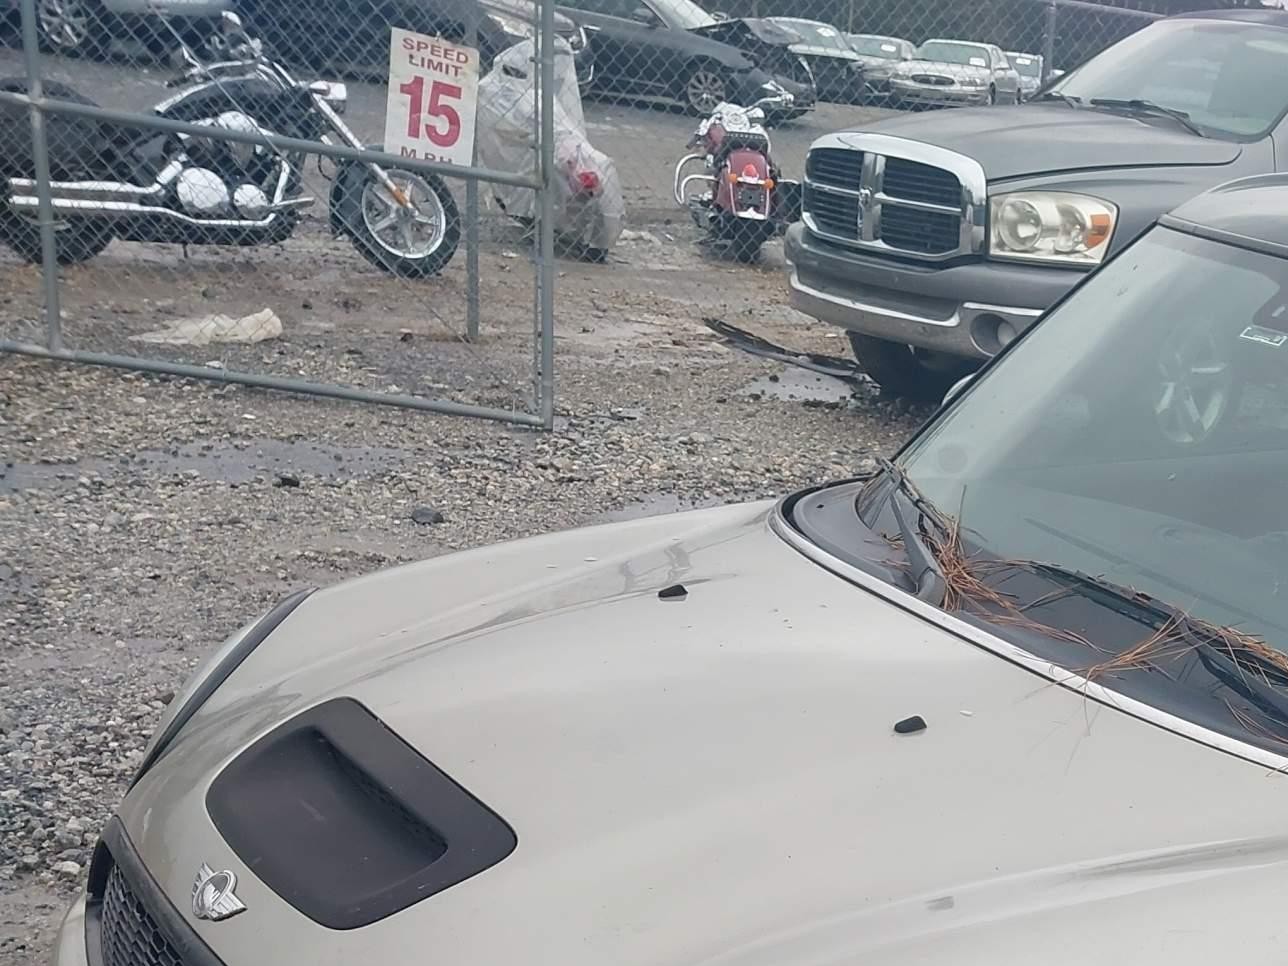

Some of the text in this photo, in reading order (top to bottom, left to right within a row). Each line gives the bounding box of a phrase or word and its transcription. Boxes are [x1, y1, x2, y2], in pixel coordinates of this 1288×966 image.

[402, 37, 469, 64] SPEED
[408, 54, 463, 77] LIMIT
[400, 75, 462, 148] 15
